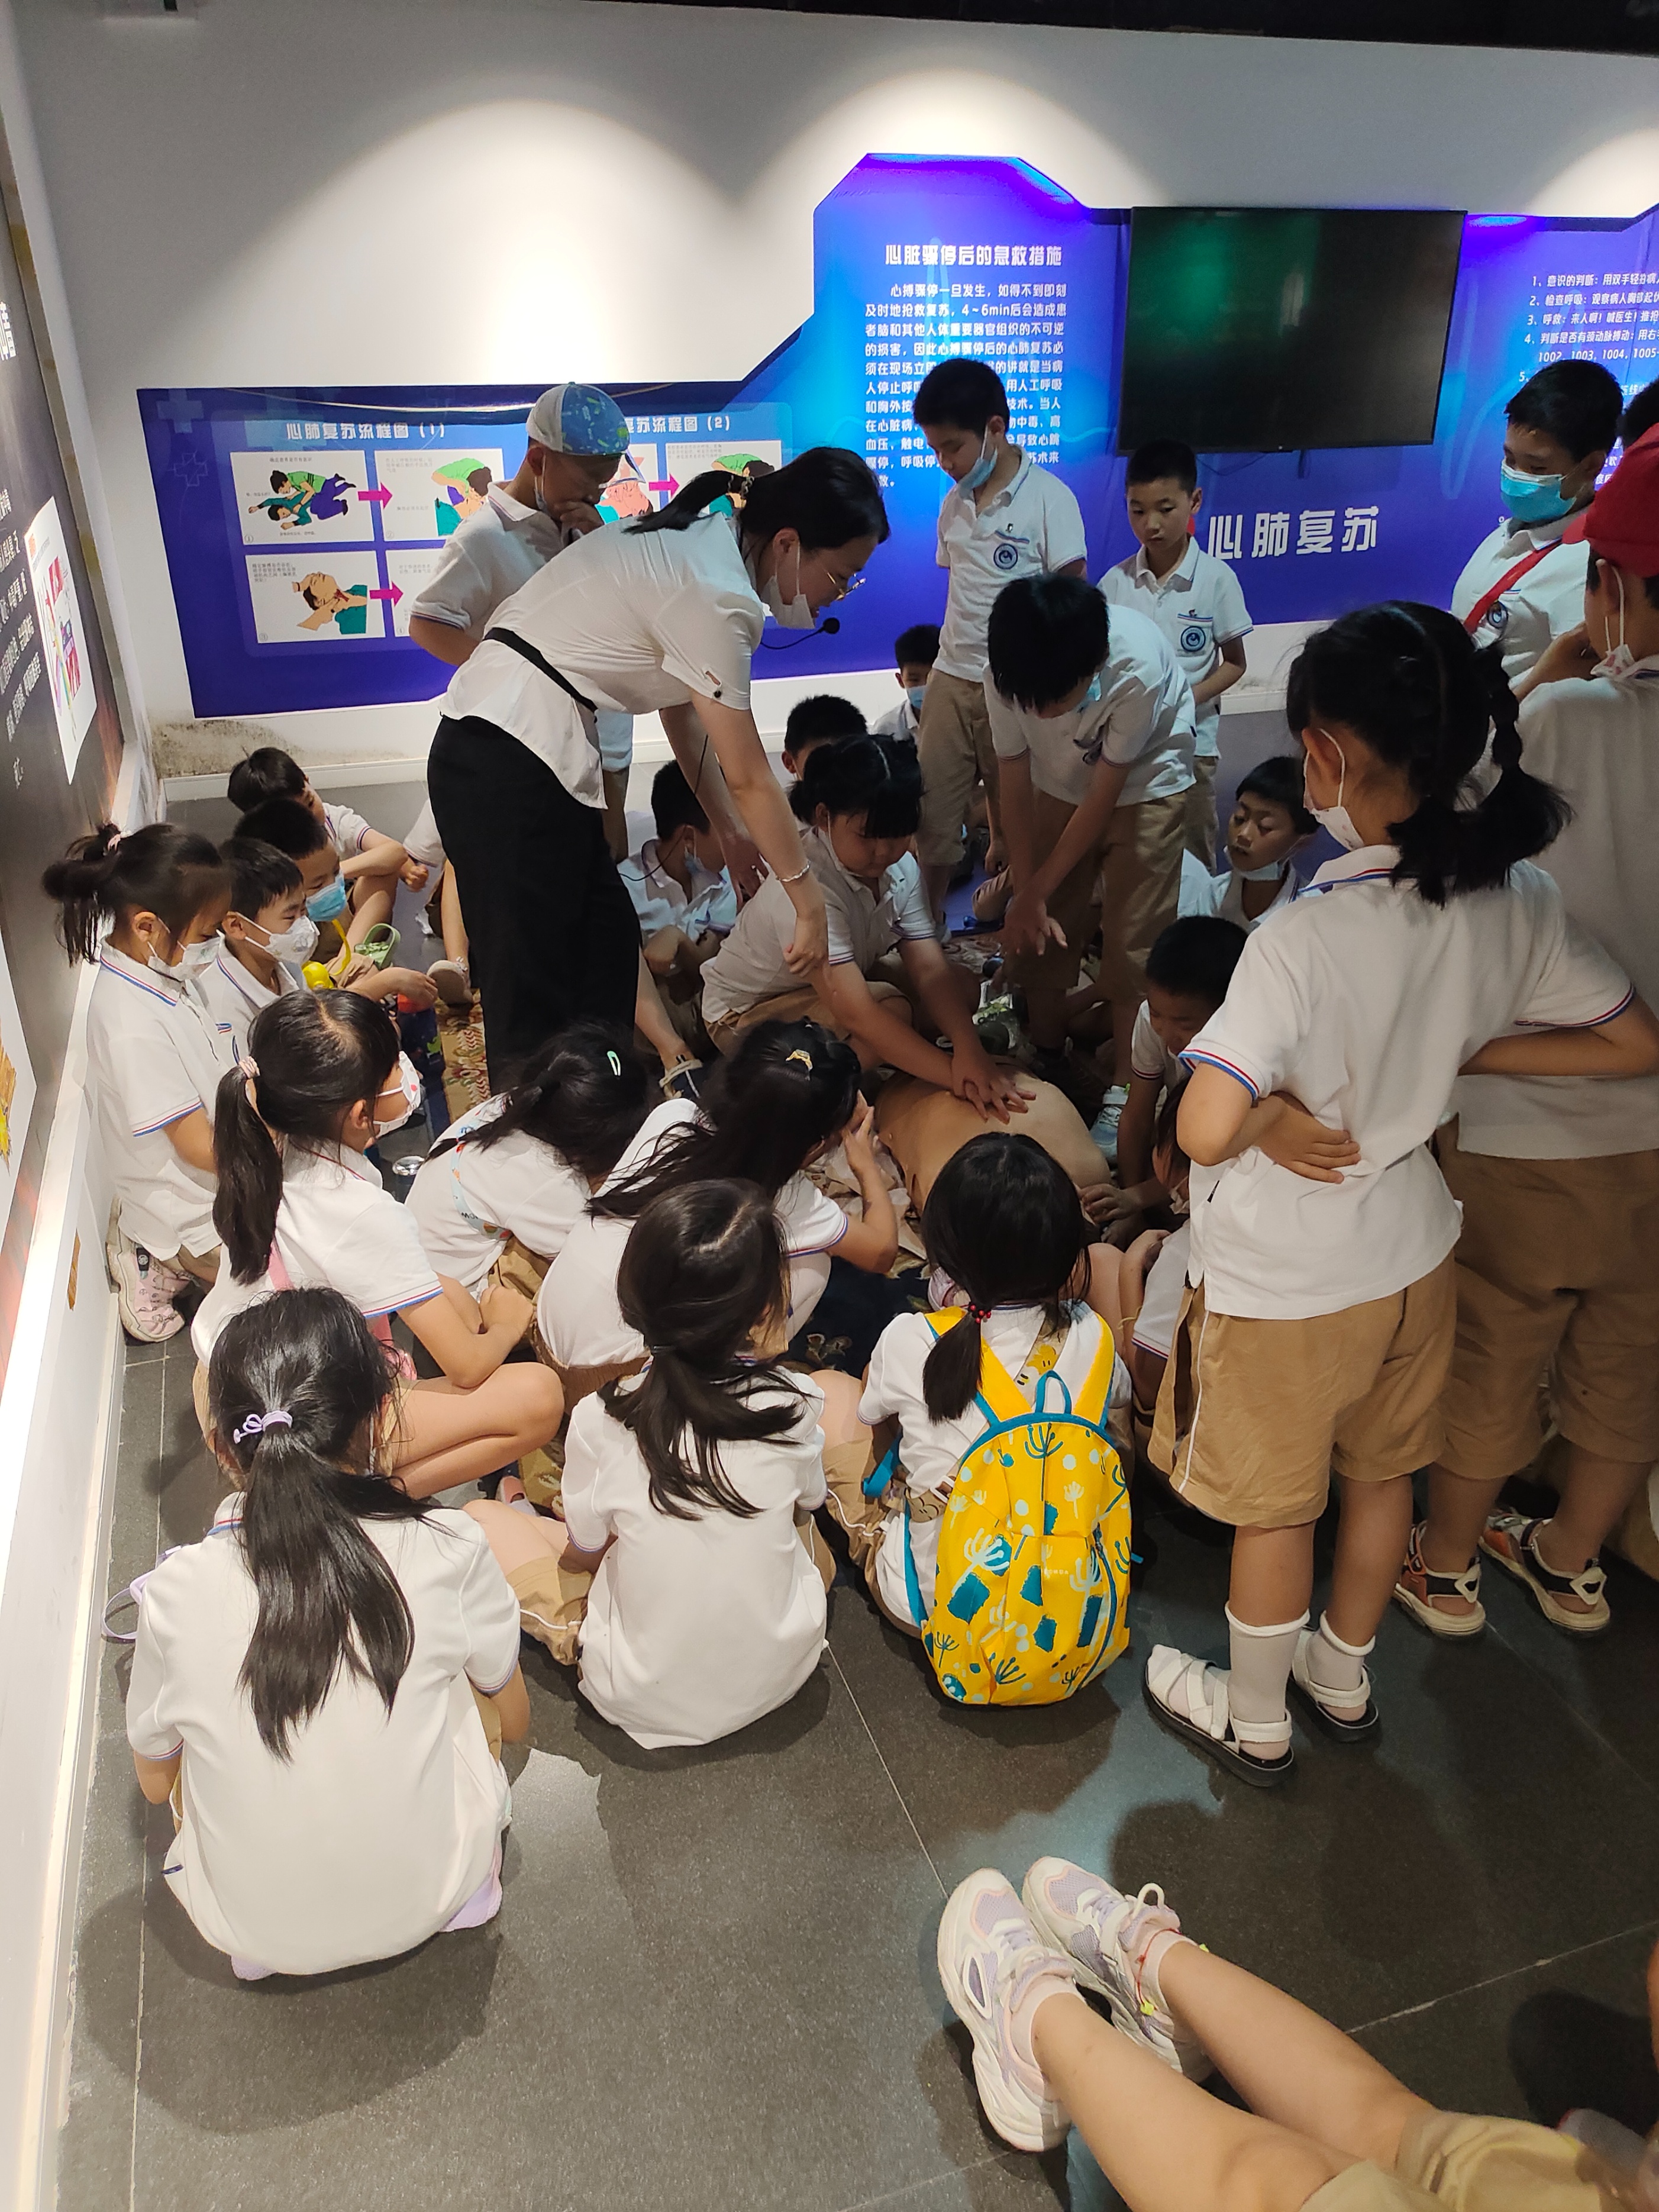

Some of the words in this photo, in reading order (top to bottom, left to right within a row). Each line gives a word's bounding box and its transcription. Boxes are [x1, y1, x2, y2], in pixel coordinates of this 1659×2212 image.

[886, 244, 1062, 266] 心脏骤停后的急救措施
[890, 283, 1067, 298] 心搏骤停一旦发生，如得不到即刻
[865, 323, 1064, 337] 者脑和其他人体重要器官组织的不可逆
[865, 341, 1064, 356] 的损害，因此心搏骤停后的心肺复苏必
[1006, 378, 1063, 392] 用人工呼吸
[1207, 506, 1379, 560] 心肺复苏
